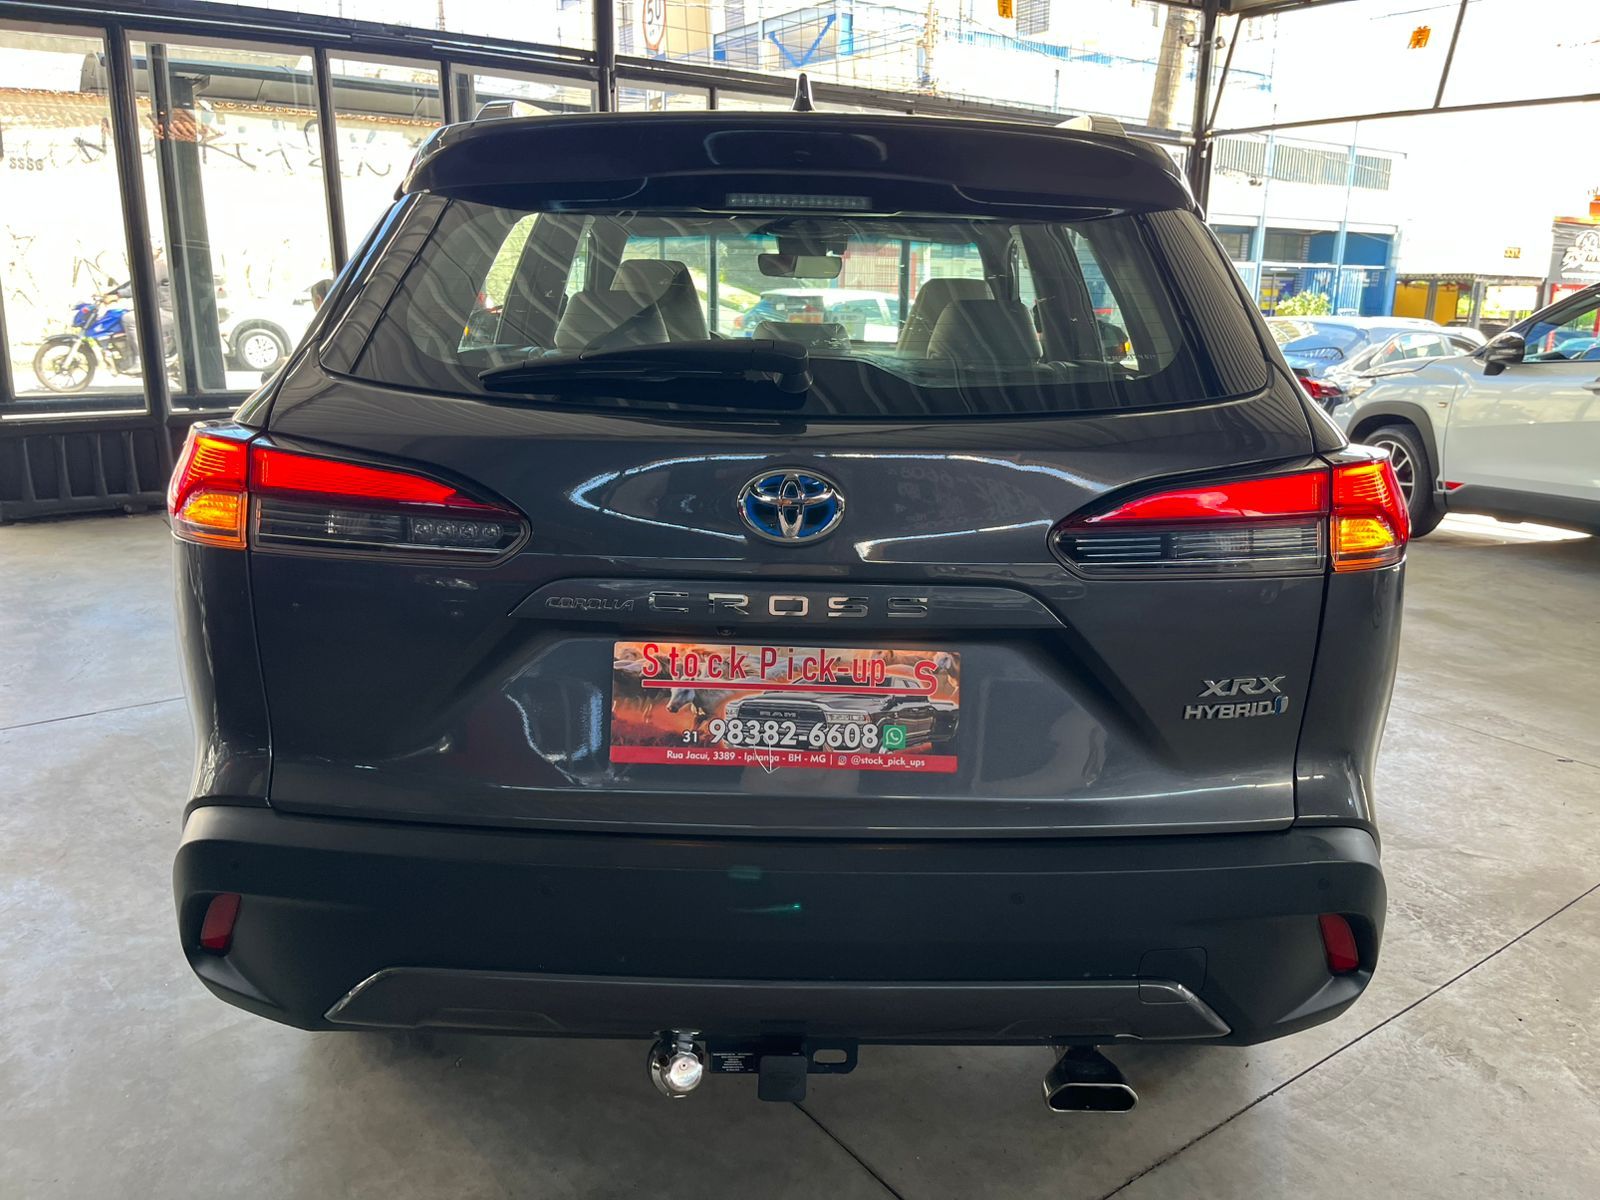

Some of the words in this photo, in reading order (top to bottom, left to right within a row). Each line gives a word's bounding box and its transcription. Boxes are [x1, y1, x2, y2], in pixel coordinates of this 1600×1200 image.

[545, 596, 635, 611] COROLLA
[648, 590, 928, 618] CROSS
[642, 643, 748, 679] Stock
[759, 646, 887, 688] Pick-up
[1198, 675, 1286, 698] XRX
[1184, 701, 1275, 719] HYBRID
[682, 730, 699, 744] 31
[708, 719, 878, 748] 98382-6608
[666, 749, 684, 760] Rua
[713, 751, 736, 761] 3389
[744, 753, 780, 764] Ipiranga
[788, 754, 802, 762] BH
[810, 754, 827, 764] MG
[851, 756, 925, 768] @stock_pick_ups
